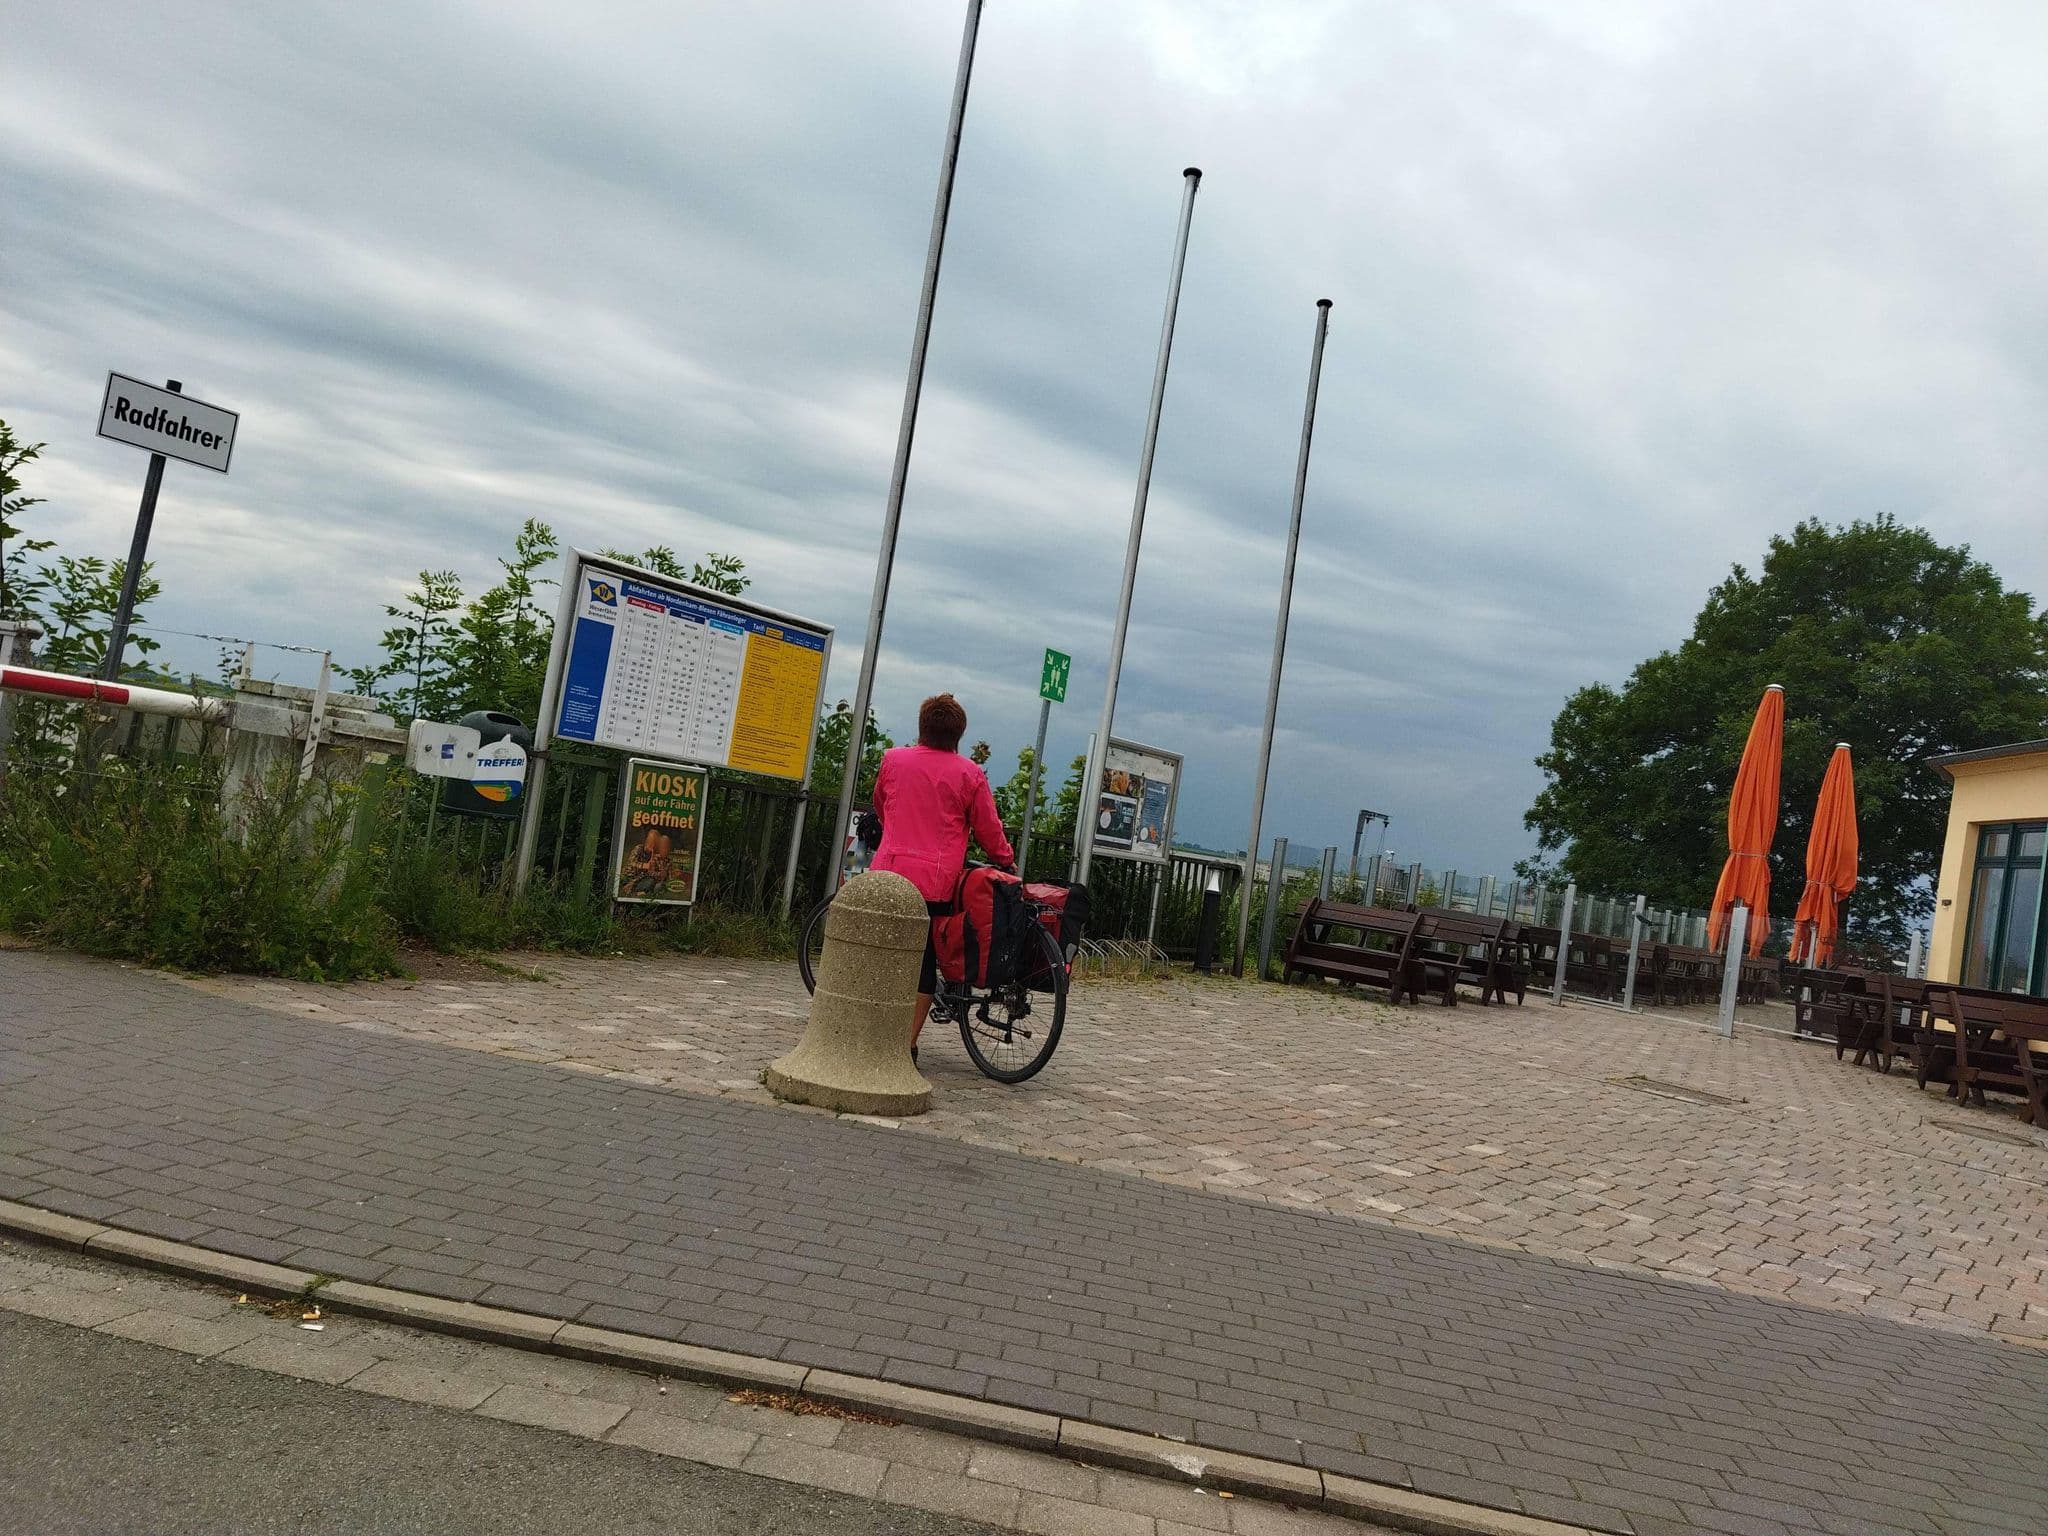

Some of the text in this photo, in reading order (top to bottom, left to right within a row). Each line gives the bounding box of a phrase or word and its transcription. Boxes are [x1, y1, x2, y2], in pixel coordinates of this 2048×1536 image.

[113, 396, 223, 450] Radfahrer
[628, 584, 658, 599] Abfahrten
[657, 593, 666, 601] ab
[477, 758, 525, 767] TREFFER!
[636, 770, 698, 799] KIOSK
[634, 795, 651, 806] auf
[652, 797, 668, 808] der
[632, 810, 694, 829] geöffnet
